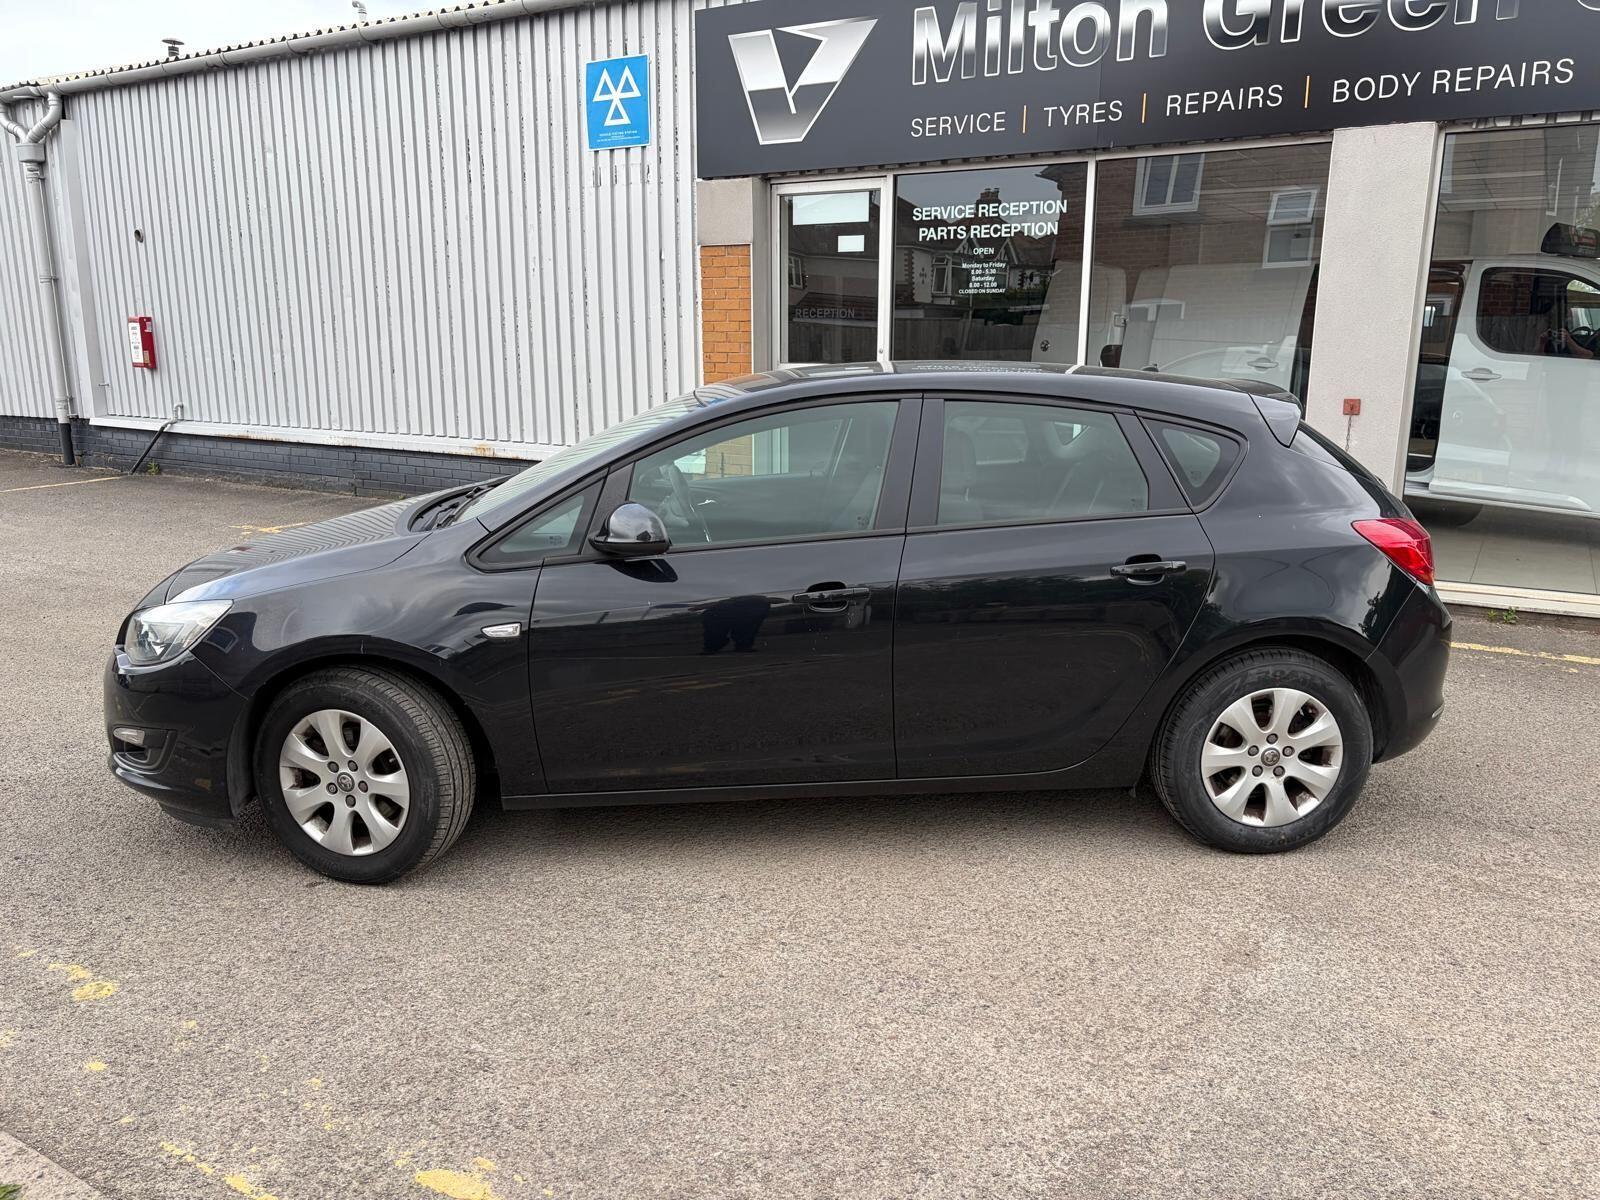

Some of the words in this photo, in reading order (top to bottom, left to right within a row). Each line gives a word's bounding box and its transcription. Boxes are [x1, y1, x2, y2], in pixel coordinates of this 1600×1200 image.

[911, 0, 1169, 86] Milton
[1202, 0, 1519, 51] Gre
[1332, 72, 1422, 103] BODY
[1432, 58, 1576, 94] REPAIRS
[1043, 100, 1123, 127] TYRES
[1165, 84, 1284, 117] REPAIRS
[910, 111, 1006, 138] SERVICE
[912, 204, 975, 221] SERVICE
[978, 199, 1068, 218] RECEPTION
[918, 225, 967, 242] PARTS
[970, 221, 1059, 239] RECEPTION
[973, 247, 995, 255] OPEN
[795, 306, 855, 319] RECEPTION
